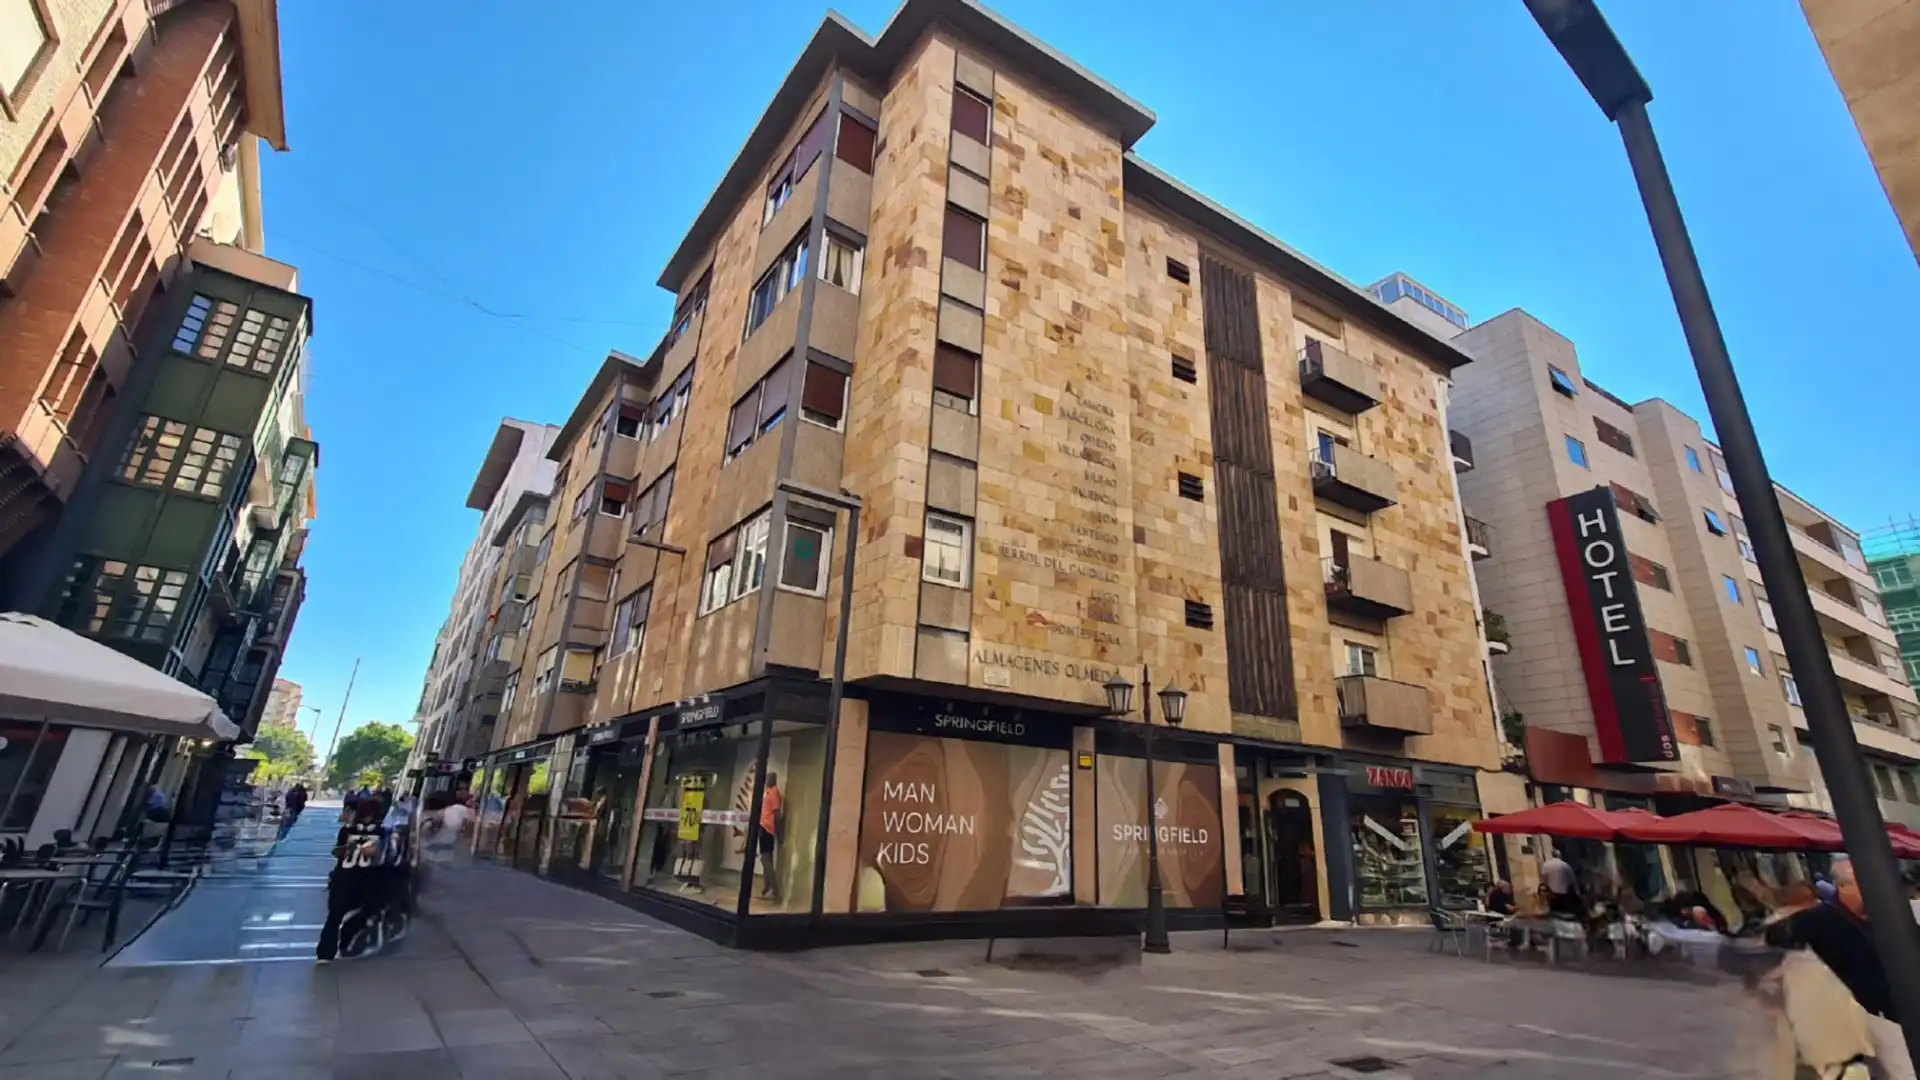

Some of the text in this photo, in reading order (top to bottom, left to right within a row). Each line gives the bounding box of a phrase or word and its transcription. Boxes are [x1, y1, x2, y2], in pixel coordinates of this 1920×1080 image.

[1578, 508, 1636, 666] HOTEL
[973, 649, 1121, 684] ALMACENES OLMED
[934, 713, 1026, 736] SPRINGFIELD
[883, 780, 936, 804] MAN
[883, 810, 975, 835] WOMAN
[1112, 823, 1209, 844] SPRIGFIELD
[879, 841, 930, 865] KIDS
